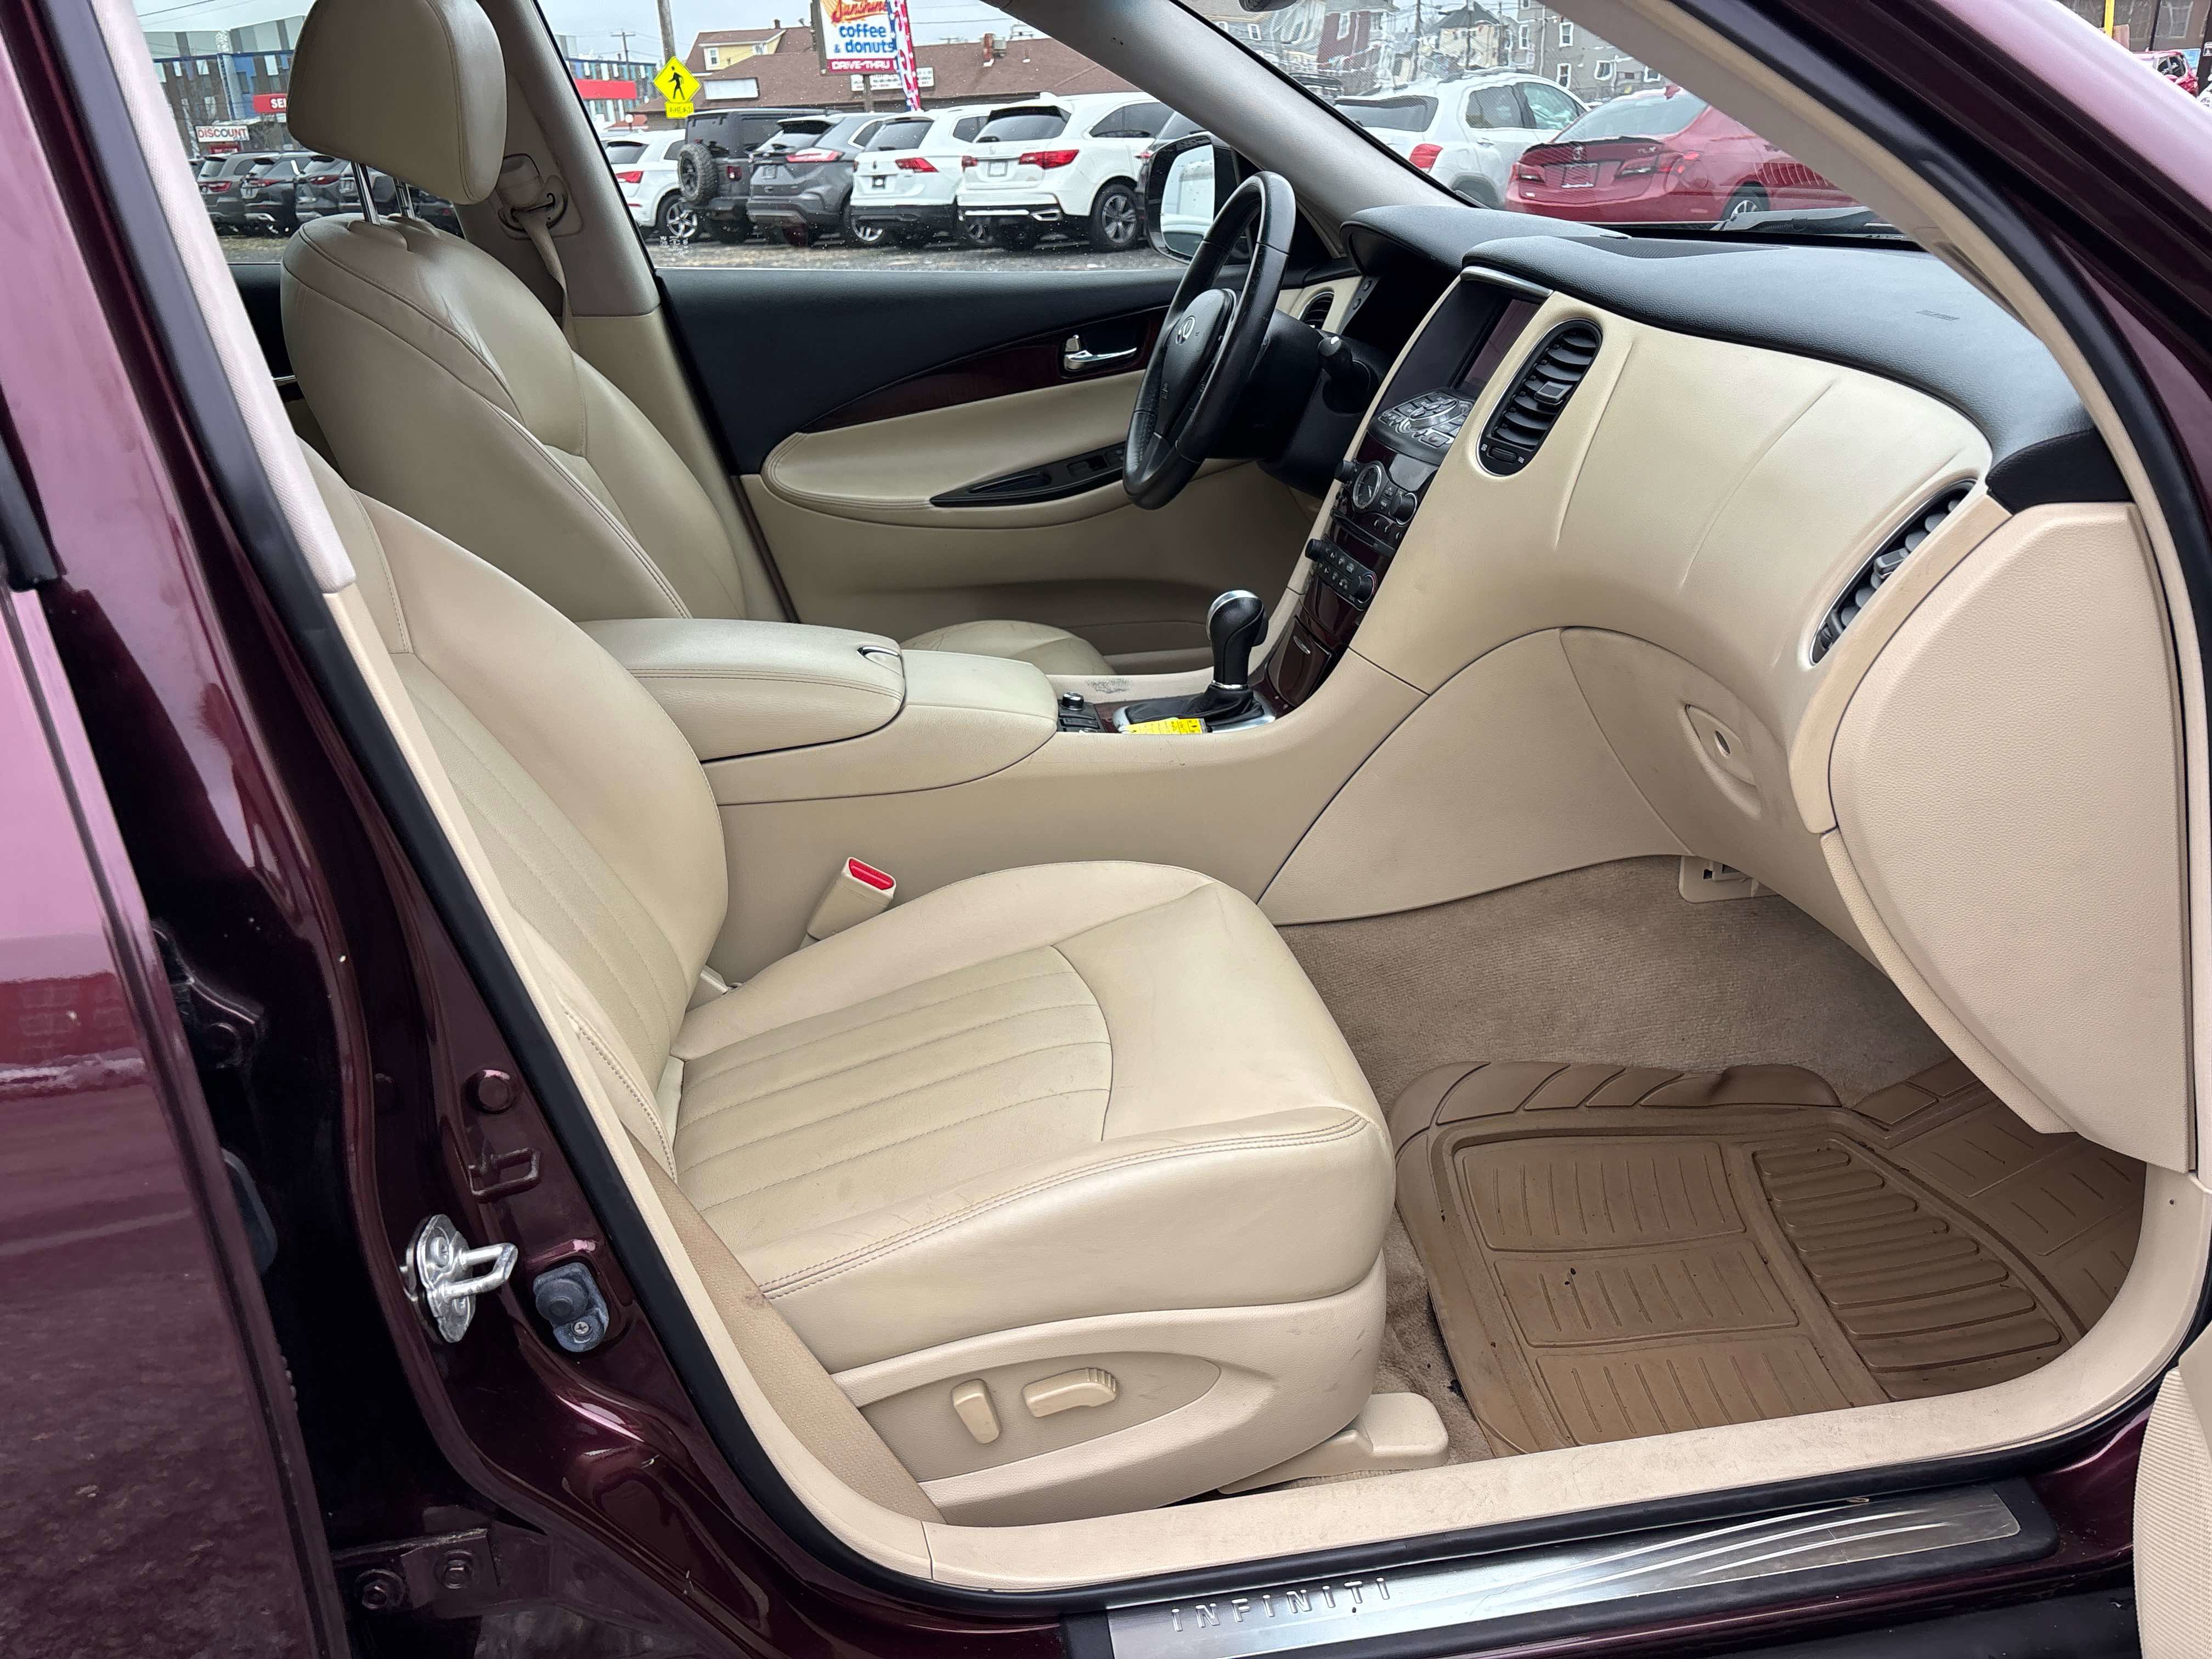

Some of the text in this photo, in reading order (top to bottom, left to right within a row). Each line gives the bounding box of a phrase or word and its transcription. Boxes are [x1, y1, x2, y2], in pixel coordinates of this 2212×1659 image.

[839, 24, 887, 38] coffee
[845, 40, 896, 53] donuts
[831, 60, 890, 70] DRIVE-THRU
[198, 128, 247, 138] DISCOUNT
[1171, 1577, 1390, 1632] INFINITI
